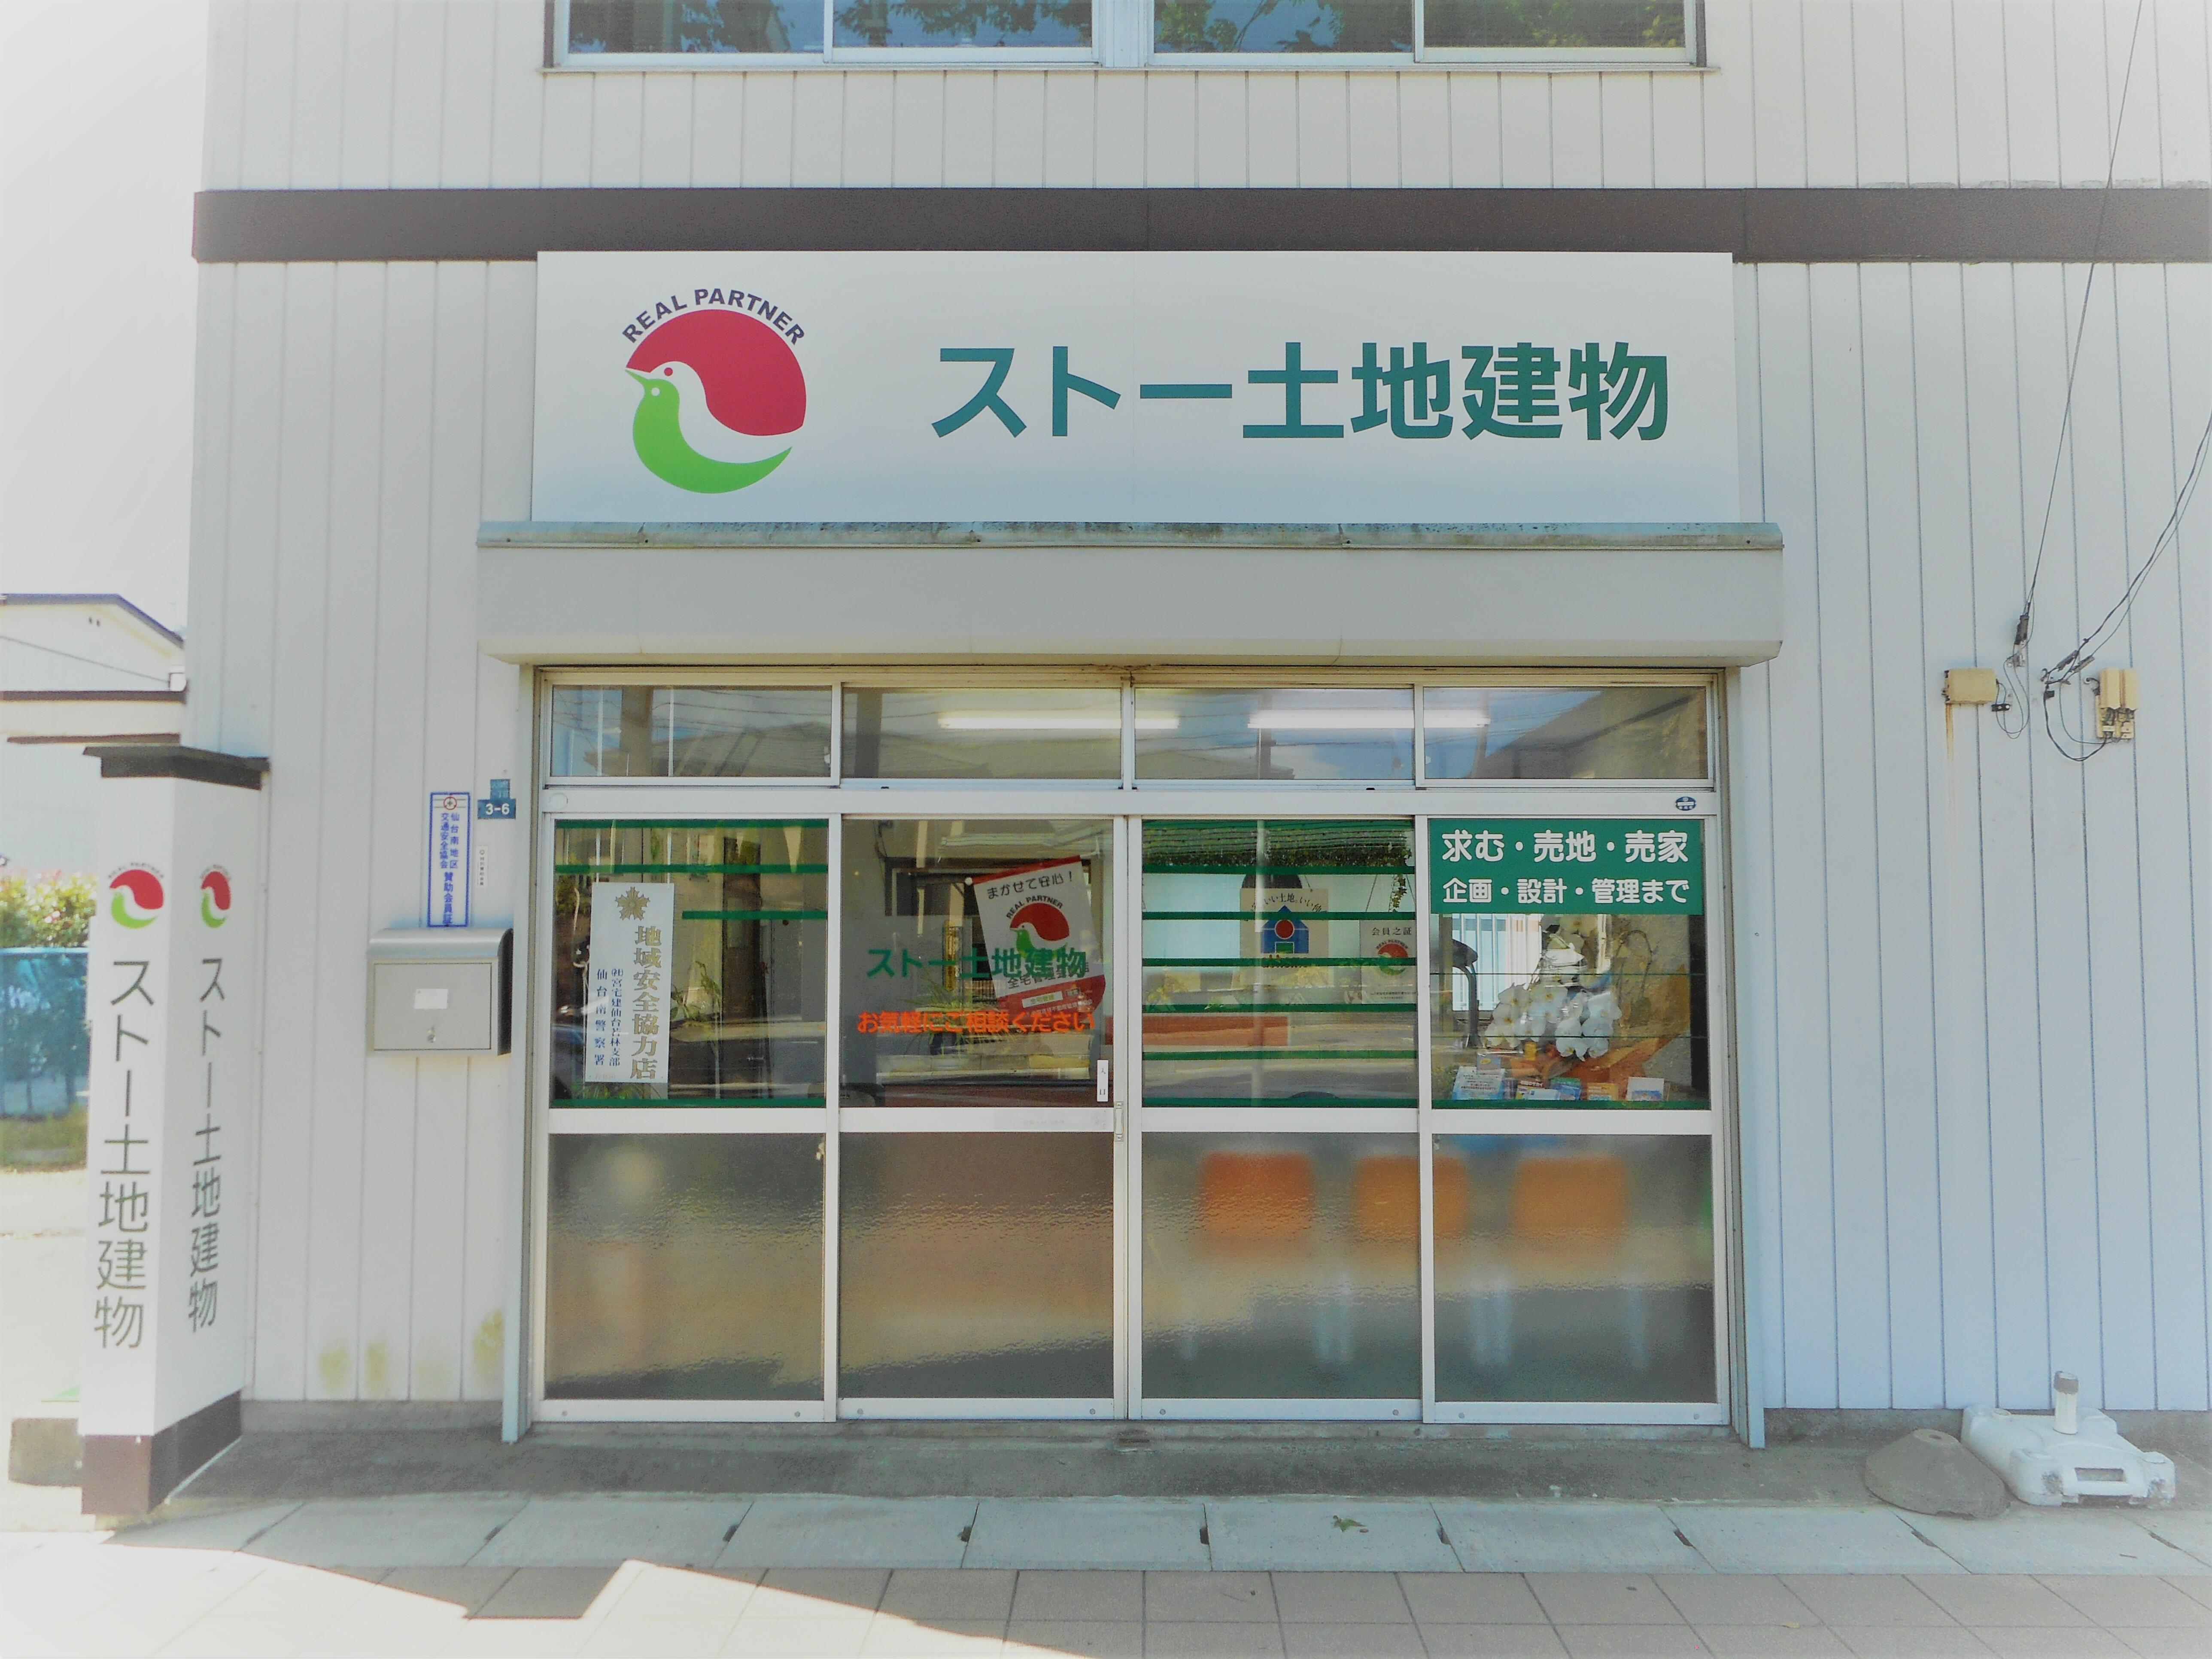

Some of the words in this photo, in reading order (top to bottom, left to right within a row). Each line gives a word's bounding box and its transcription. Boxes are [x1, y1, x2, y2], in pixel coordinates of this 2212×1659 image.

[622, 295, 687, 343] REAL
[694, 288, 805, 345] PARTNER
[931, 341, 1669, 441] ストー土地建物
[485, 803, 510, 815] 3-6
[440, 812, 449, 869] 交通安全協会
[450, 813, 459, 869] 仙台南地区
[1442, 830, 1689, 863] 求む・売地・売家
[1006, 900, 1024, 919] REAL
[1026, 895, 1063, 909] PARTNER
[1443, 878, 1689, 904] 企画・設計・管理まで
[1372, 927, 1412, 936] 会員之証
[867, 947, 1086, 979] ストー土地建物
[594, 969, 608, 1066] 仙台南警察署
[629, 926, 662, 1080] 地域安全協力店
[857, 1011, 1095, 1034] お気軽にご相談ください
[94, 960, 155, 1349] ストー土地建物
[188, 957, 225, 1332] ストー土地建物
